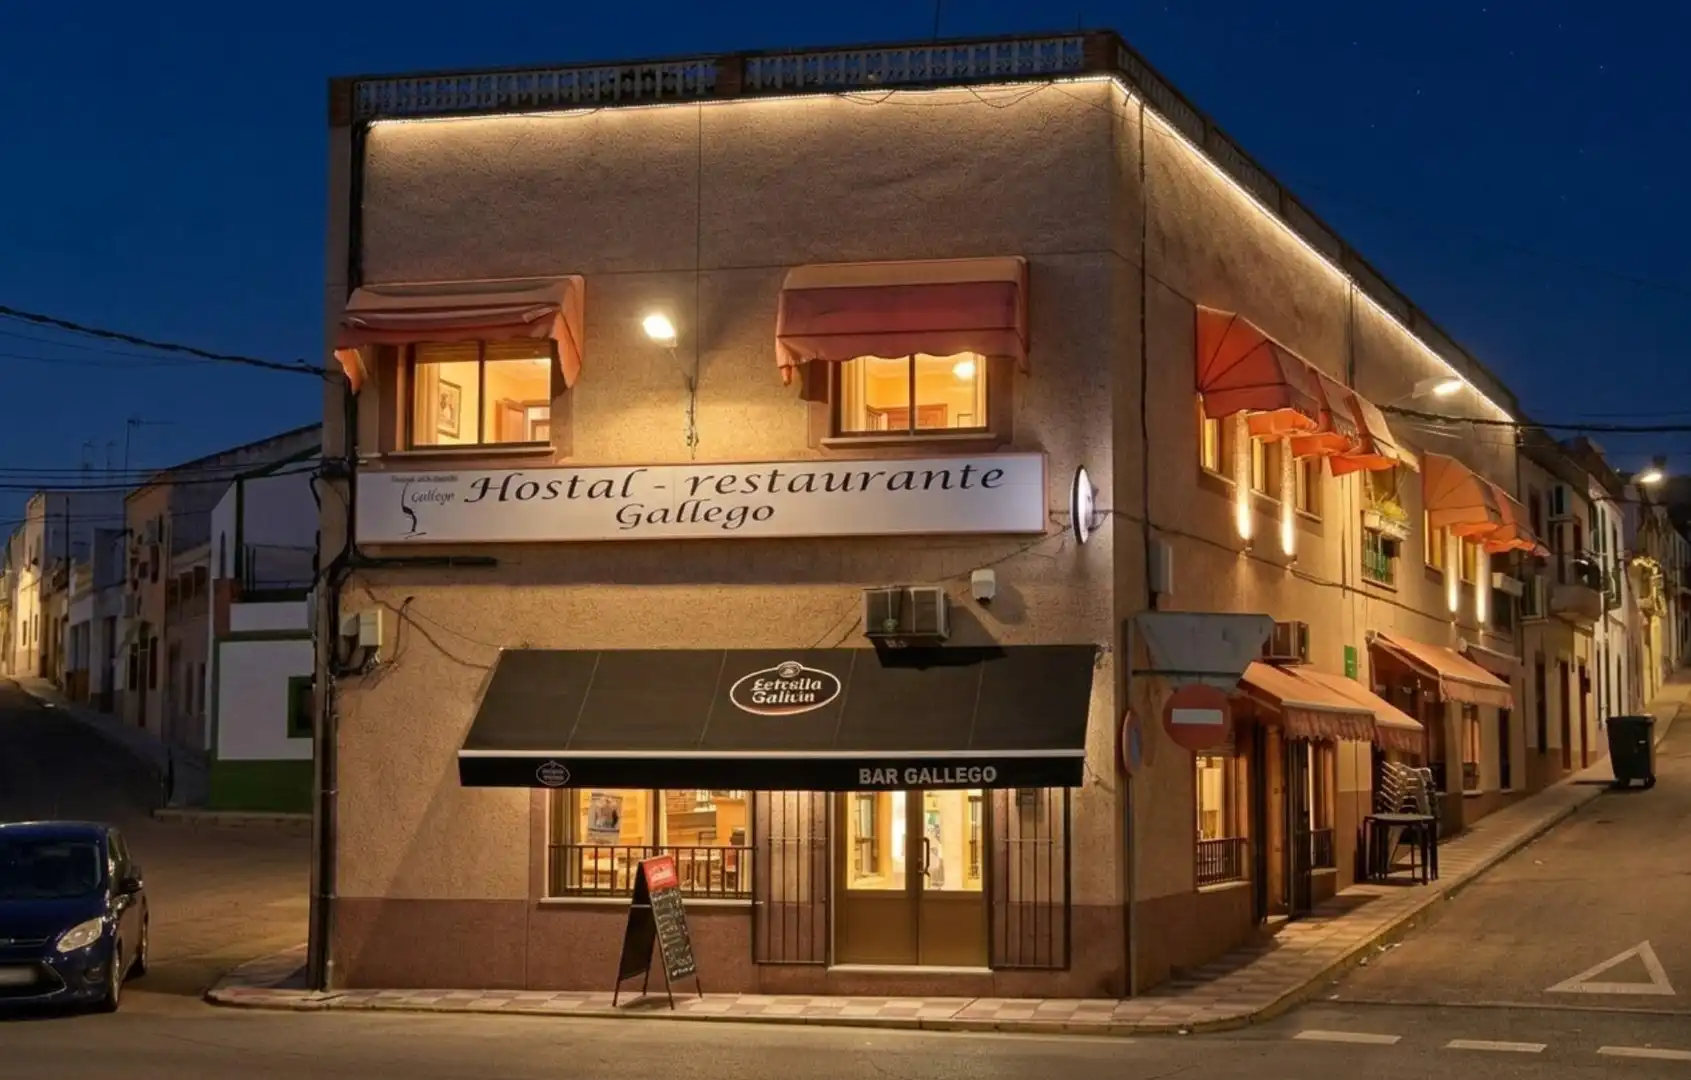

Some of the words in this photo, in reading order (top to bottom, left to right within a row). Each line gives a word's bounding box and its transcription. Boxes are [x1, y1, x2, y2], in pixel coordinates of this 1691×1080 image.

[463, 468, 647, 503] Hostal
[684, 463, 1005, 497] restaurante
[615, 498, 775, 531] Gallego
[858, 768, 899, 785] BAR
[904, 766, 998, 785] GALLEGO
